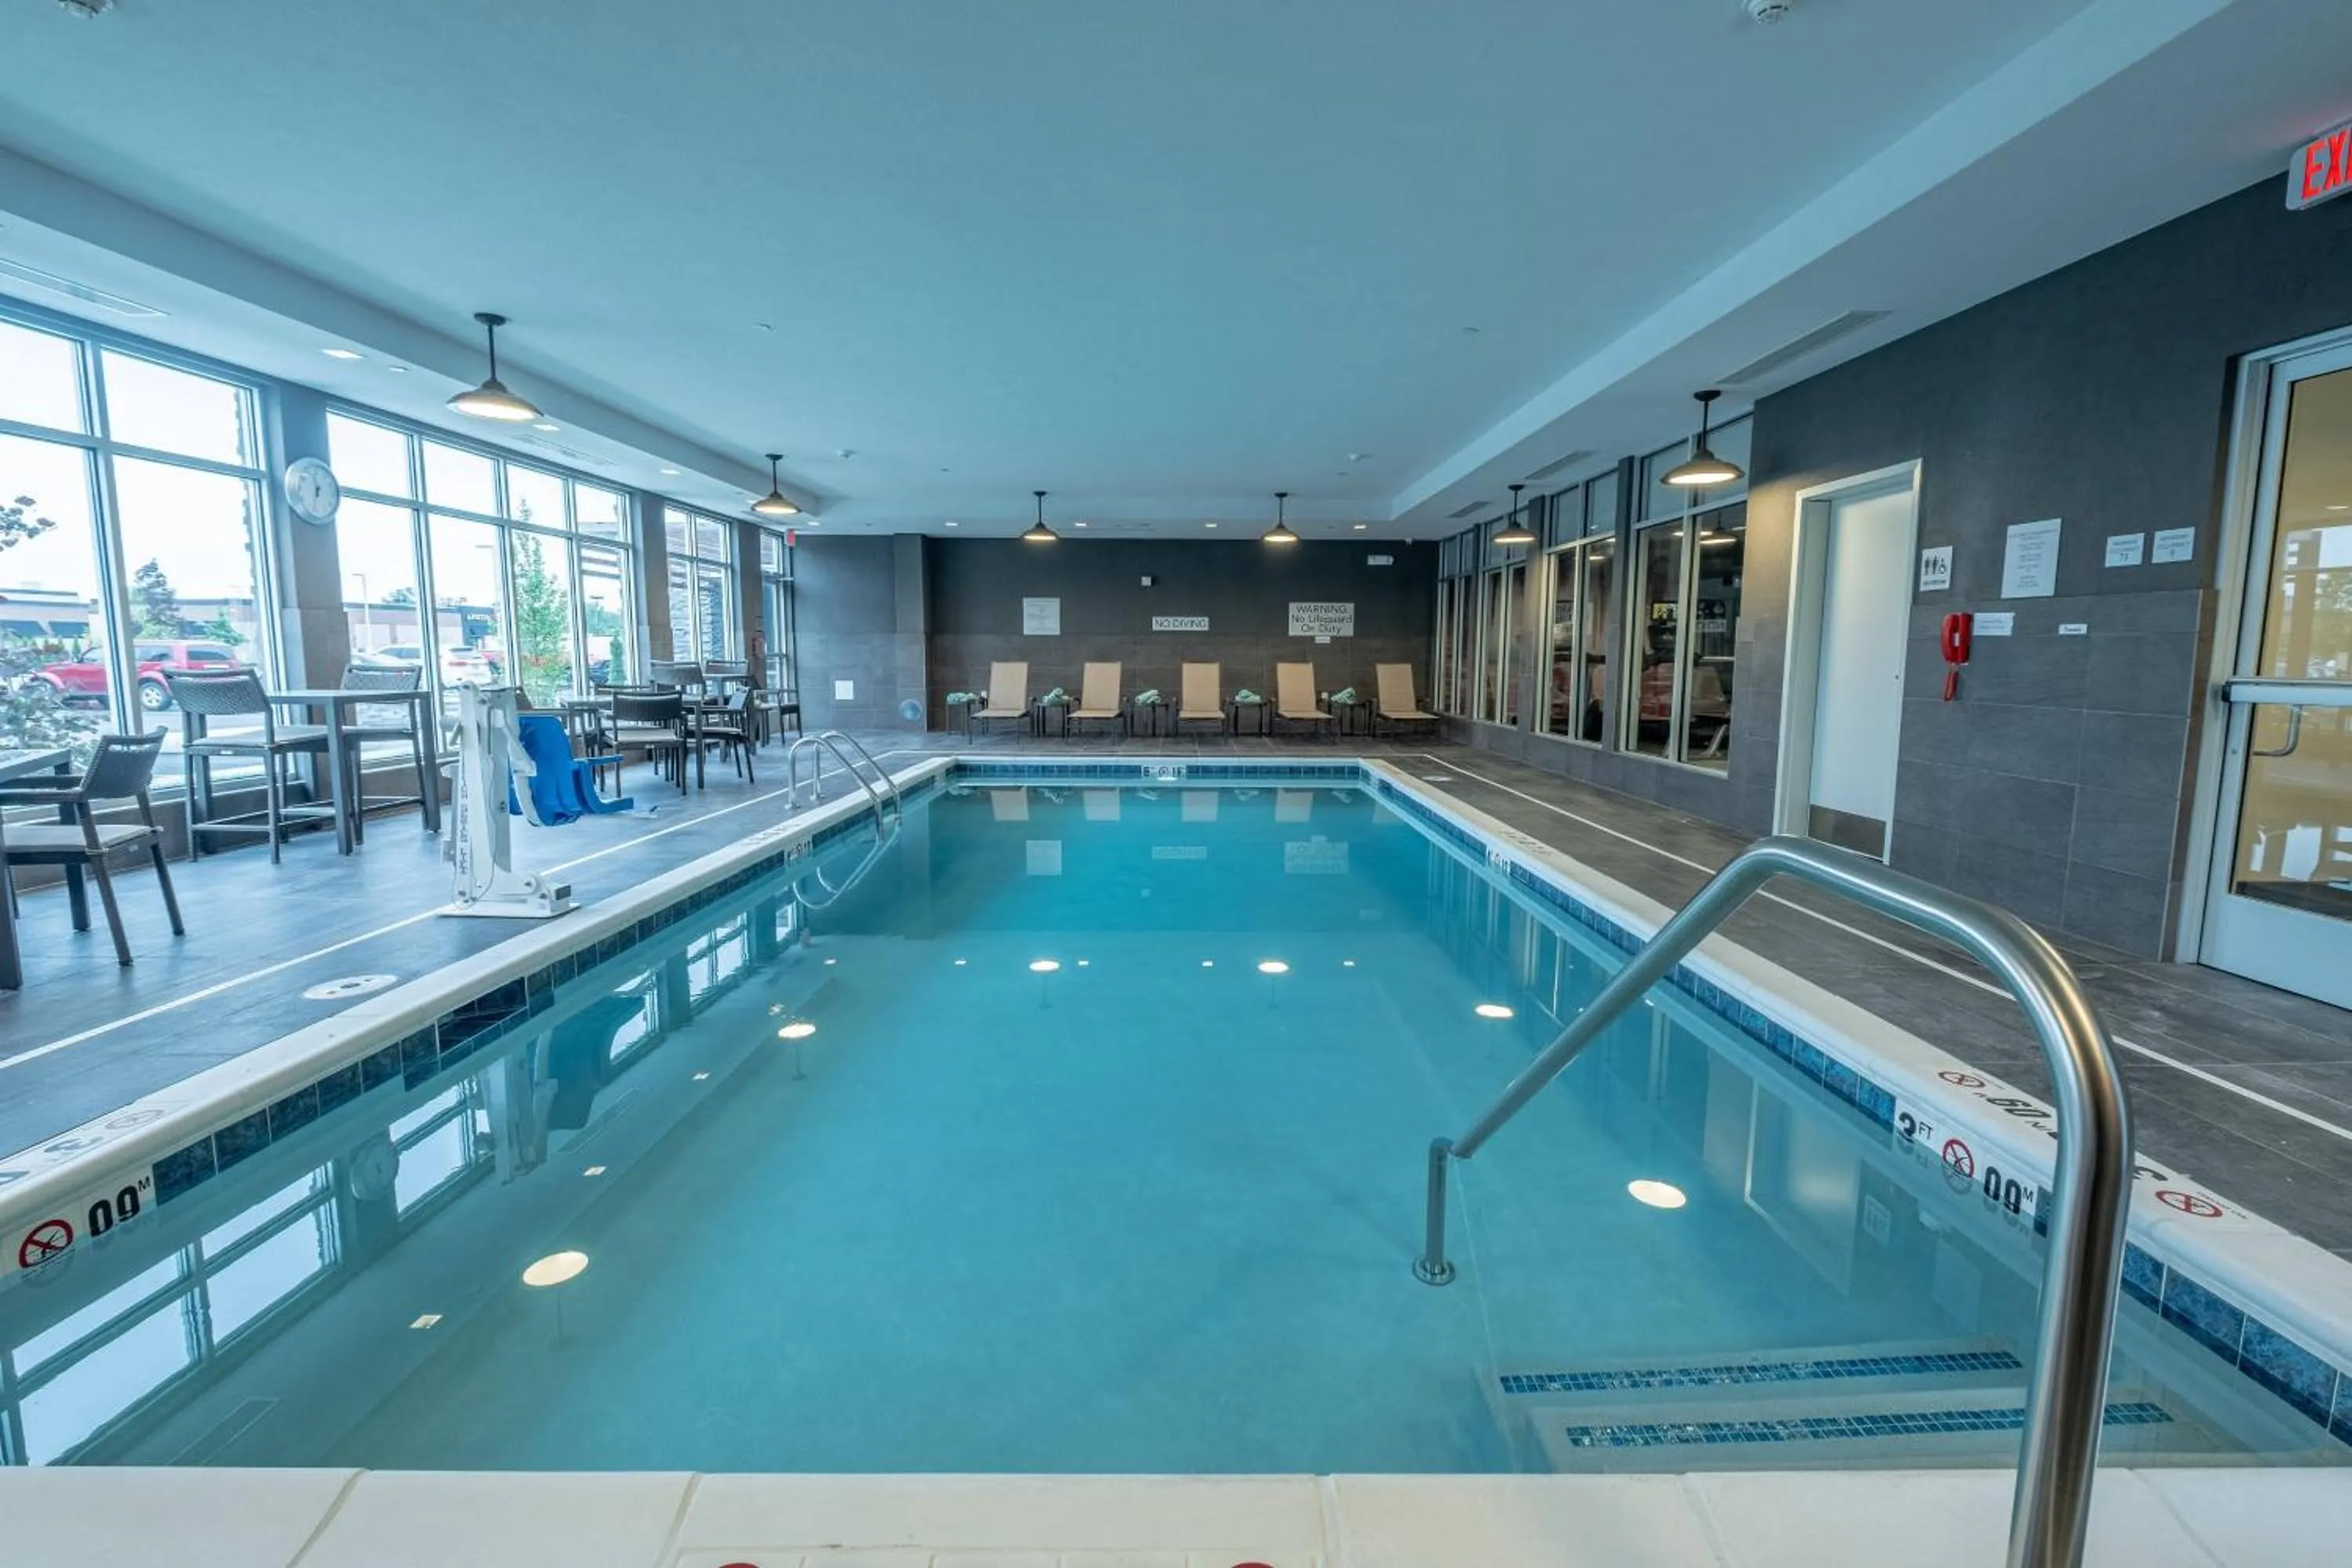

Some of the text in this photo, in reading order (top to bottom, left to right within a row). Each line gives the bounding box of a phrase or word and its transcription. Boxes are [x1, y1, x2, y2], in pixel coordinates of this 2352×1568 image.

[1296, 604, 1347, 613] WARNING
[1155, 619, 1207, 627] NO DIVING
[1291, 614, 1352, 626] No Lifeguard
[1319, 623, 1342, 635] Duty
[1918, 1122, 1933, 1140] FT
